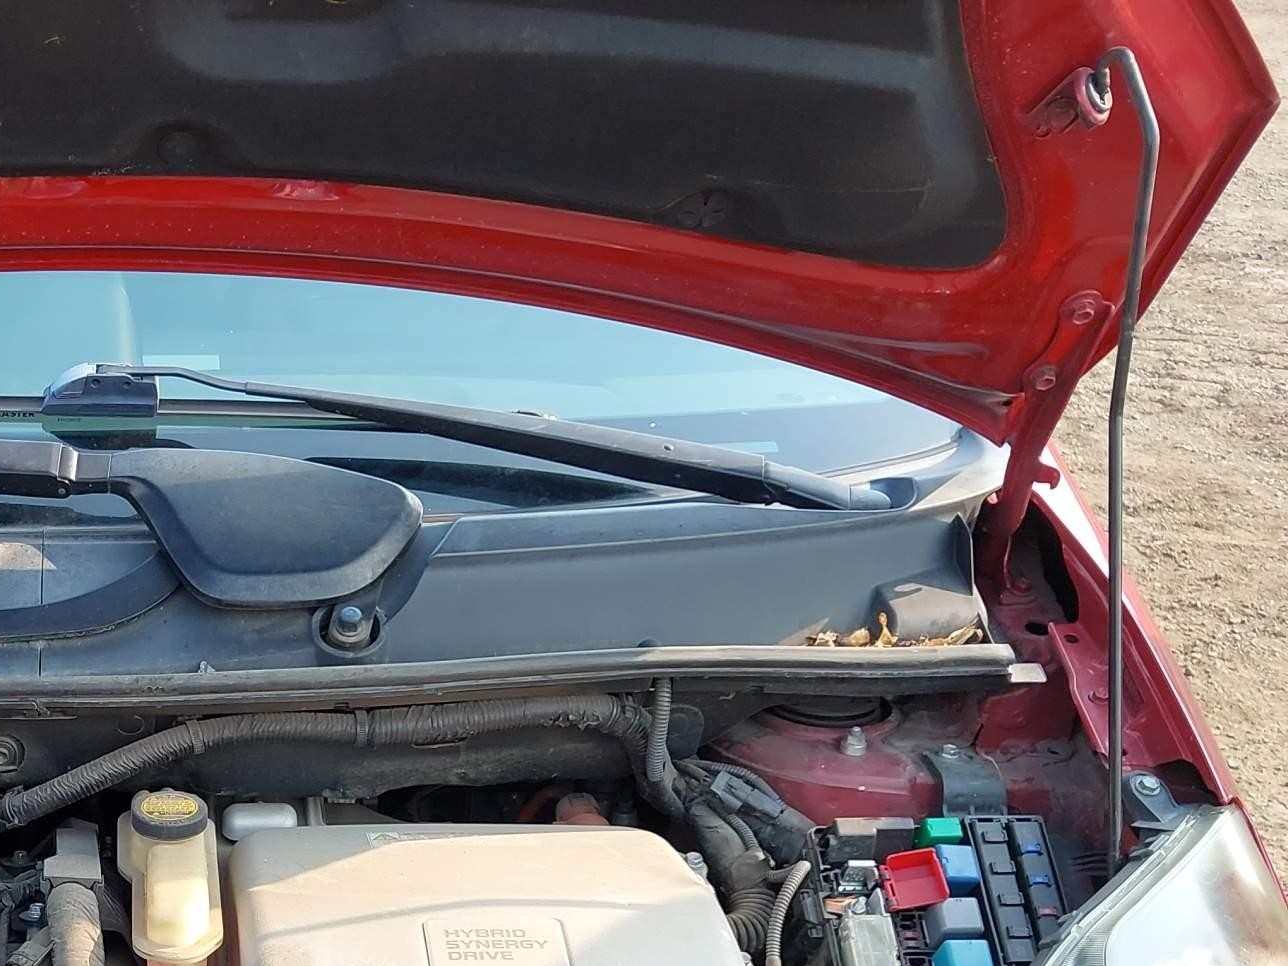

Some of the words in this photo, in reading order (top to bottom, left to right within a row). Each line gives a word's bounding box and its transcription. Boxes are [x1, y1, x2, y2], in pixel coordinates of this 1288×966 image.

[444, 929, 527, 938] HYBRID
[445, 940, 548, 949] SYNERGY
[447, 951, 514, 961] DRIVE
